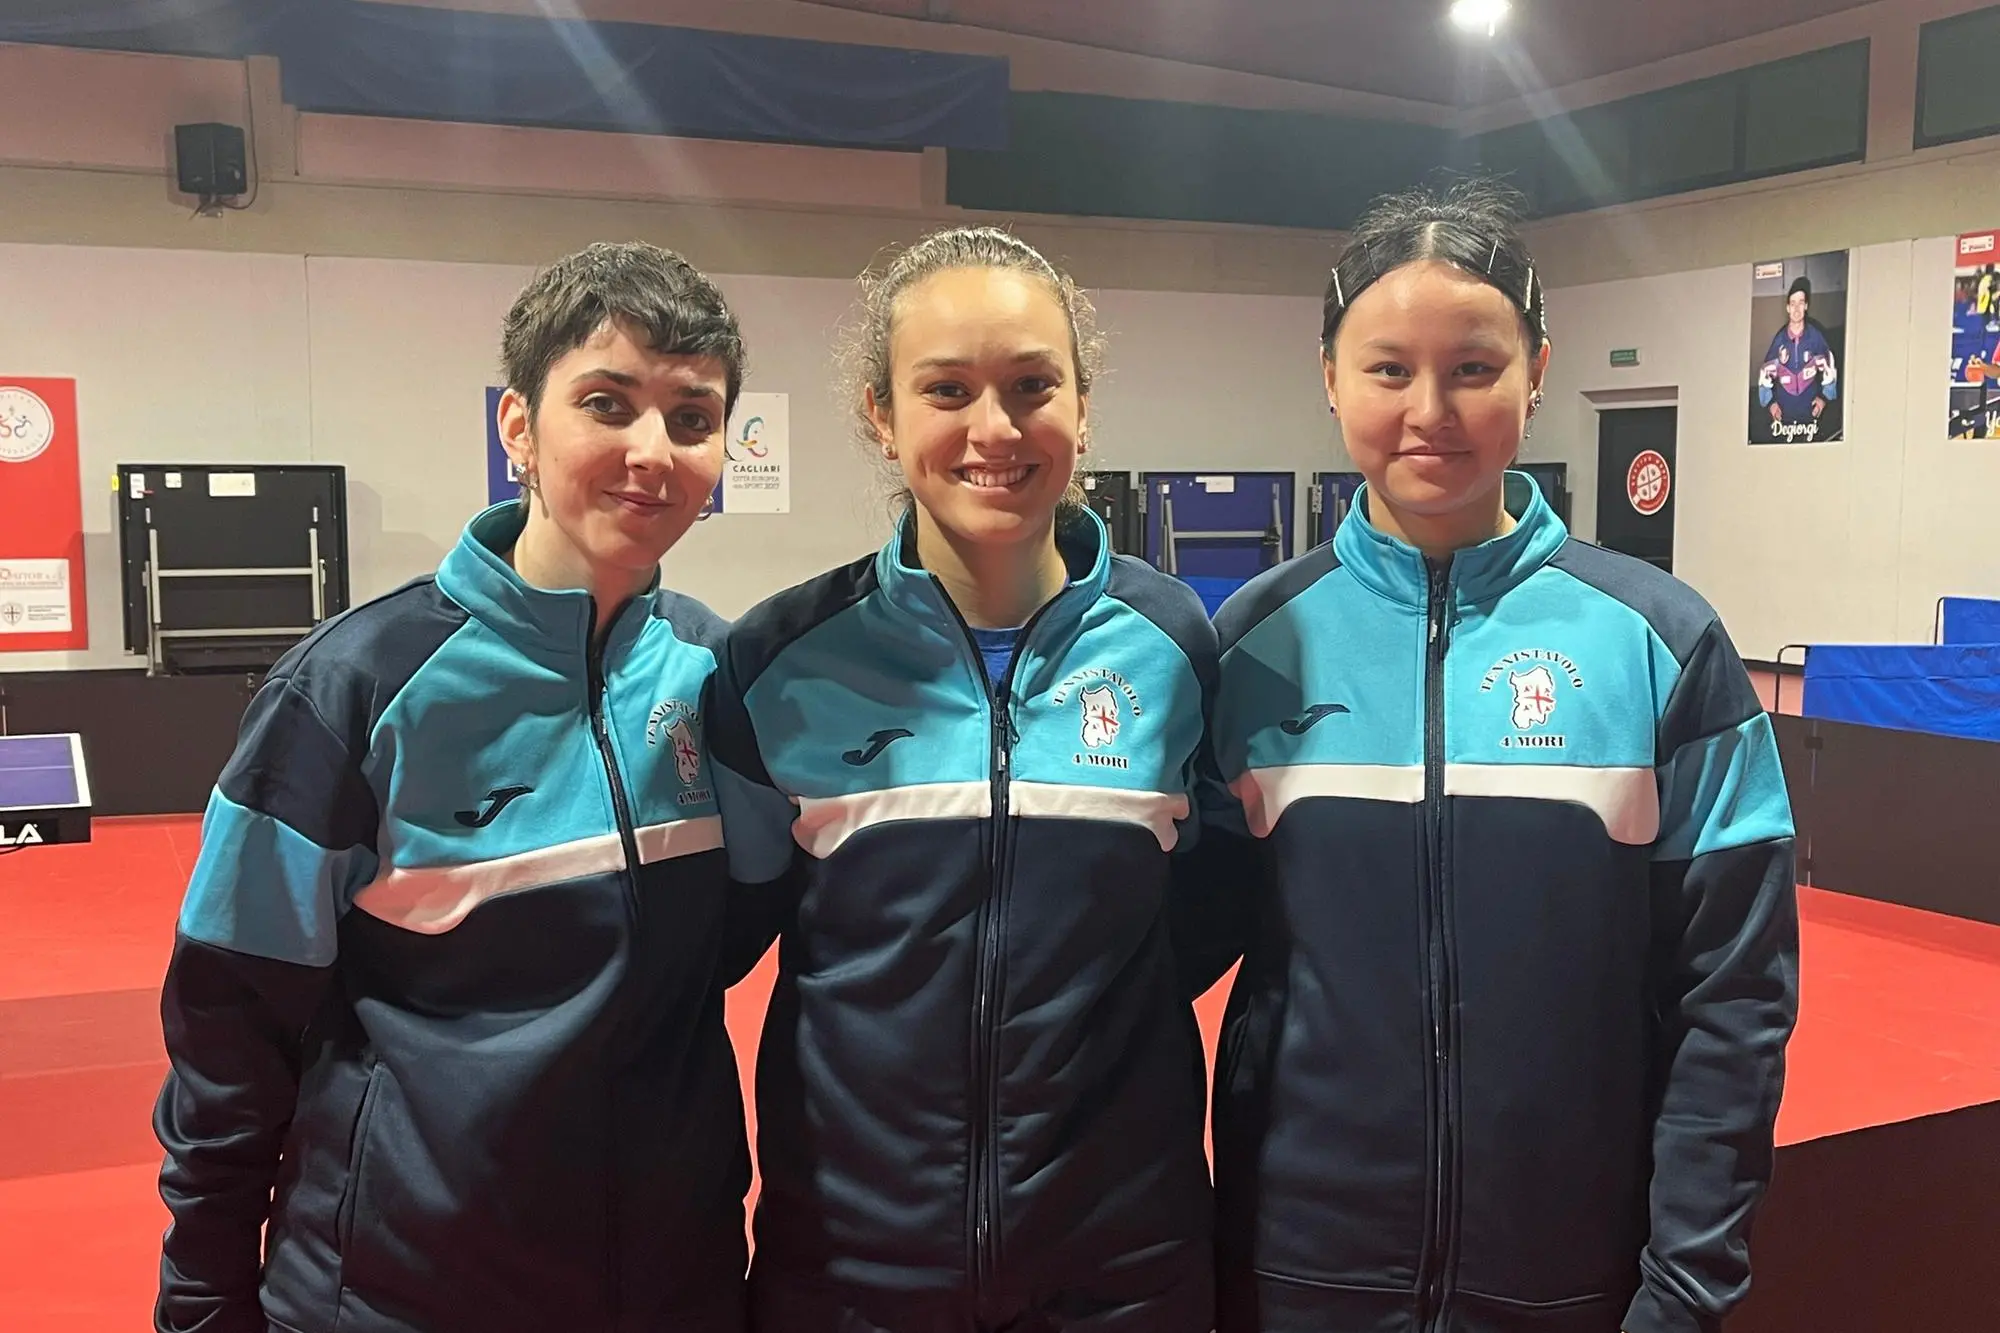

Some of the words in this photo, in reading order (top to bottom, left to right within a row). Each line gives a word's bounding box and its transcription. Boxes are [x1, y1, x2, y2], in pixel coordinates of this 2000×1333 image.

[1771, 419, 1819, 442] Degiorgi
[732, 464, 781, 473] CAGLIARI
[1480, 649, 1583, 690] TENNISTAVOLO
[1053, 668, 1142, 717] TENNISTAVOLO
[1500, 737, 1510, 747] 4
[1517, 736, 1564, 747] MORI
[1072, 754, 1081, 764] 4
[1087, 754, 1128, 769] MORI
